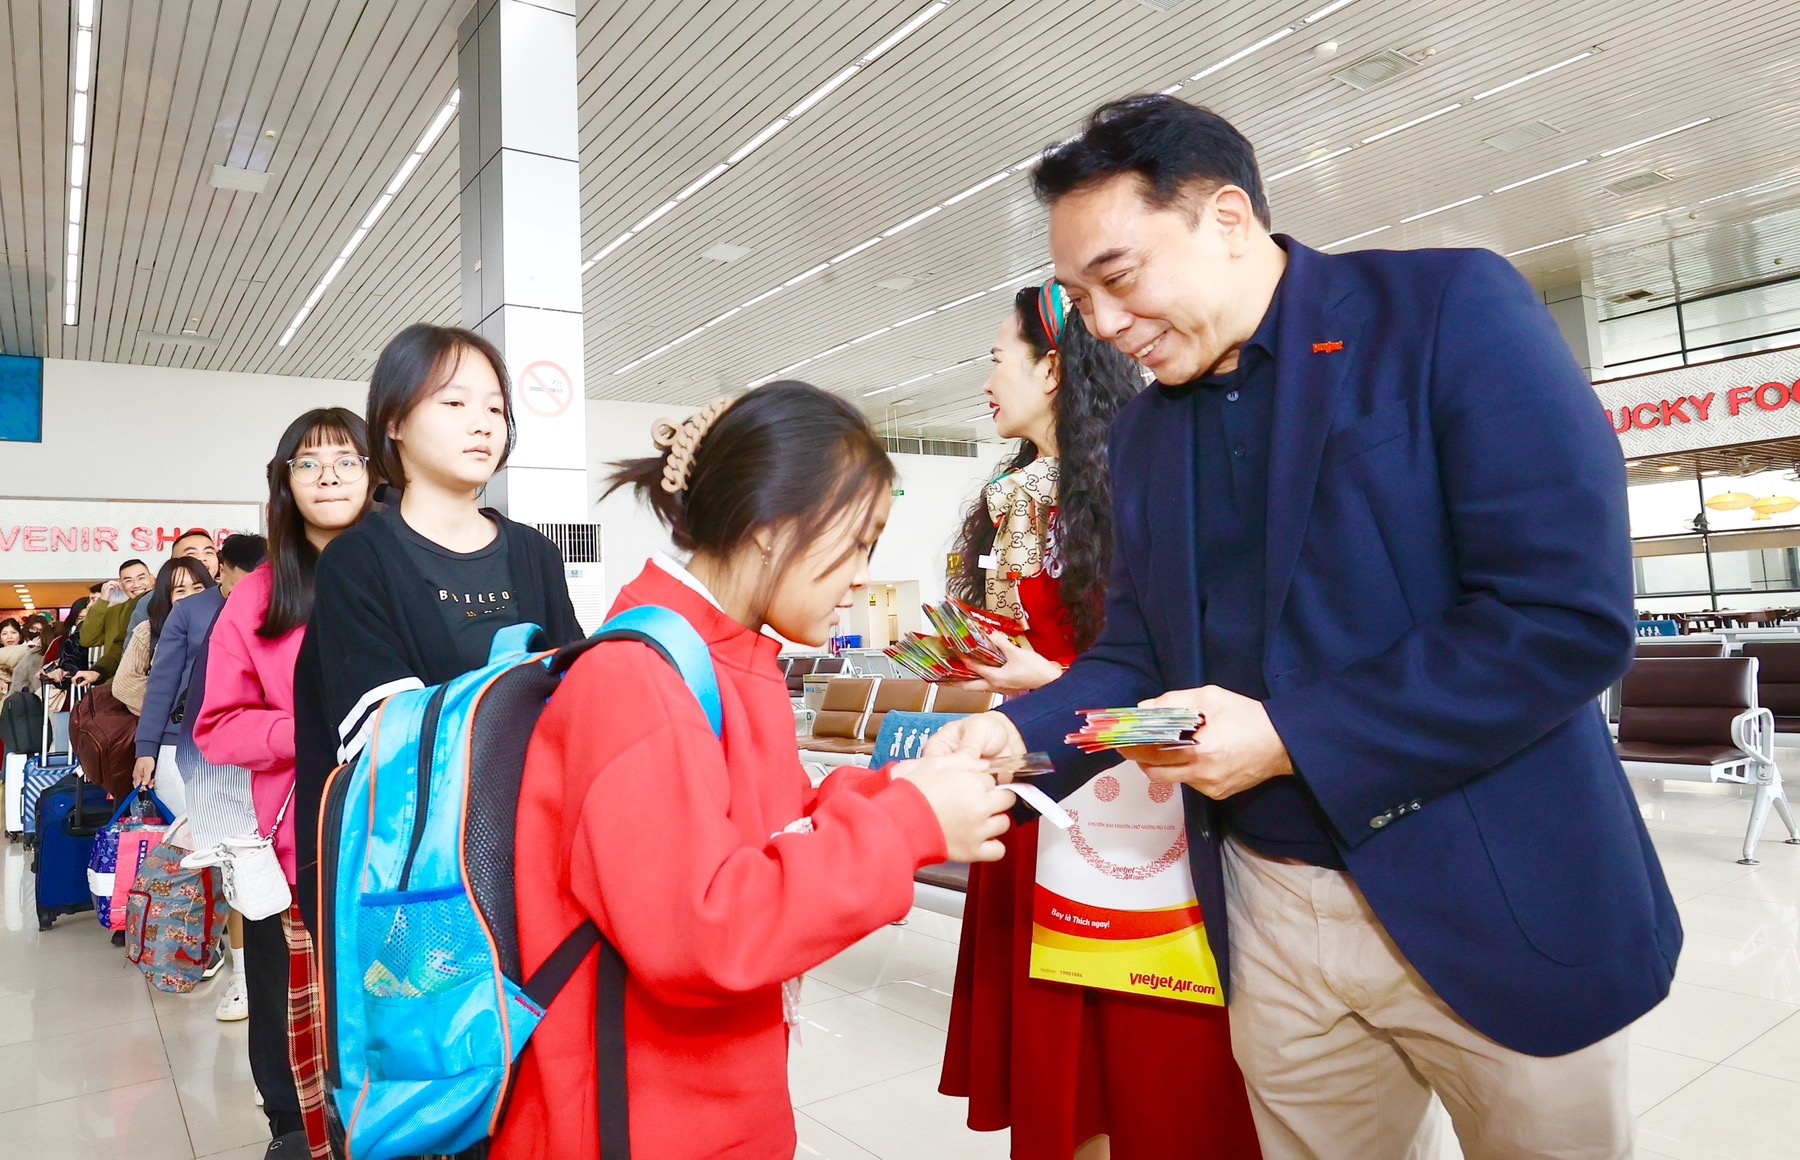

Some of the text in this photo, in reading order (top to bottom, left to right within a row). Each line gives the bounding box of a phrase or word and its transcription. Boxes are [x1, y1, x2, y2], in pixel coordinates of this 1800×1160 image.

[1605, 379, 1800, 434] UCKY FO
[0, 526, 119, 552] VENIR
[1051, 908, 1064, 920] Bay
[1091, 920, 1110, 929] ngay!
